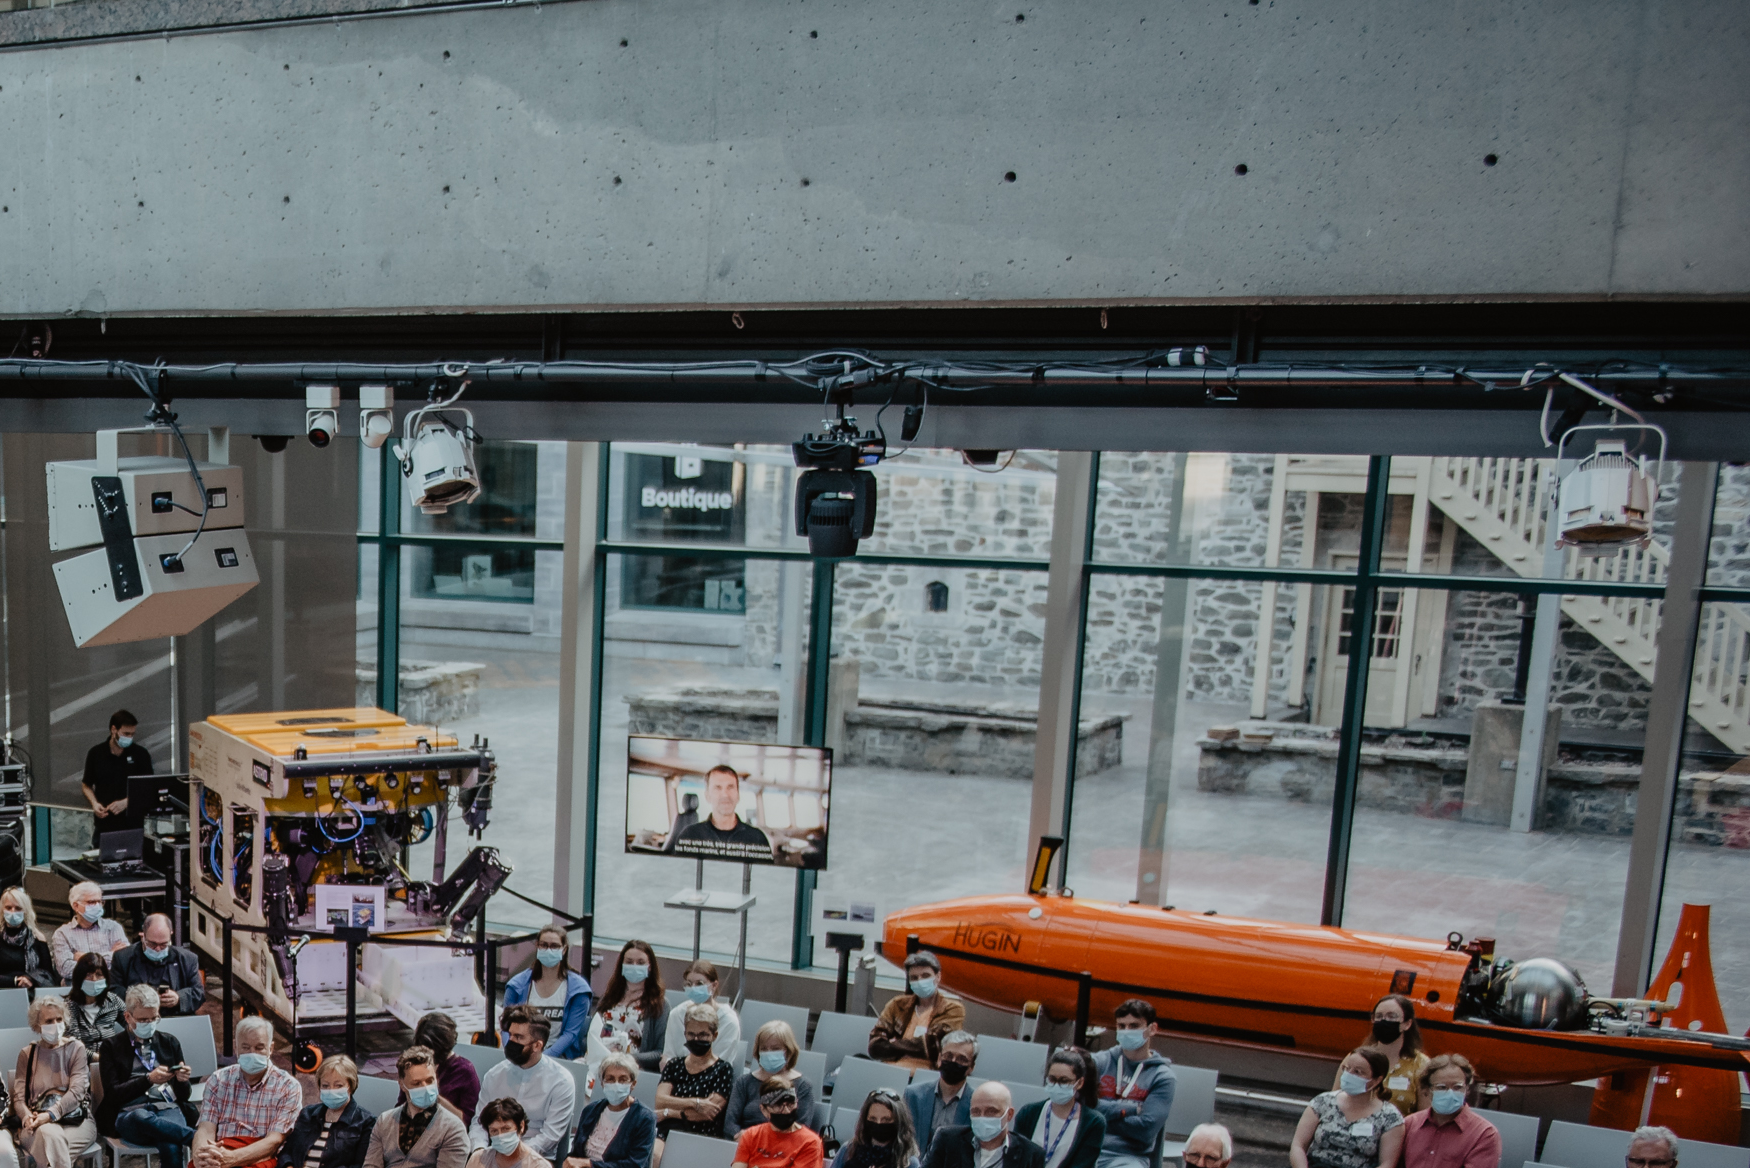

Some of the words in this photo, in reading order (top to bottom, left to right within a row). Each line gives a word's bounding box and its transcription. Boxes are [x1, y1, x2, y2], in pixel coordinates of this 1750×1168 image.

[641, 486, 733, 513] Boutique
[684, 845, 699, 853] fonds
[726, 842, 745, 851] grande
[746, 843, 771, 852] précision
[953, 921, 1022, 954] HUGIN
